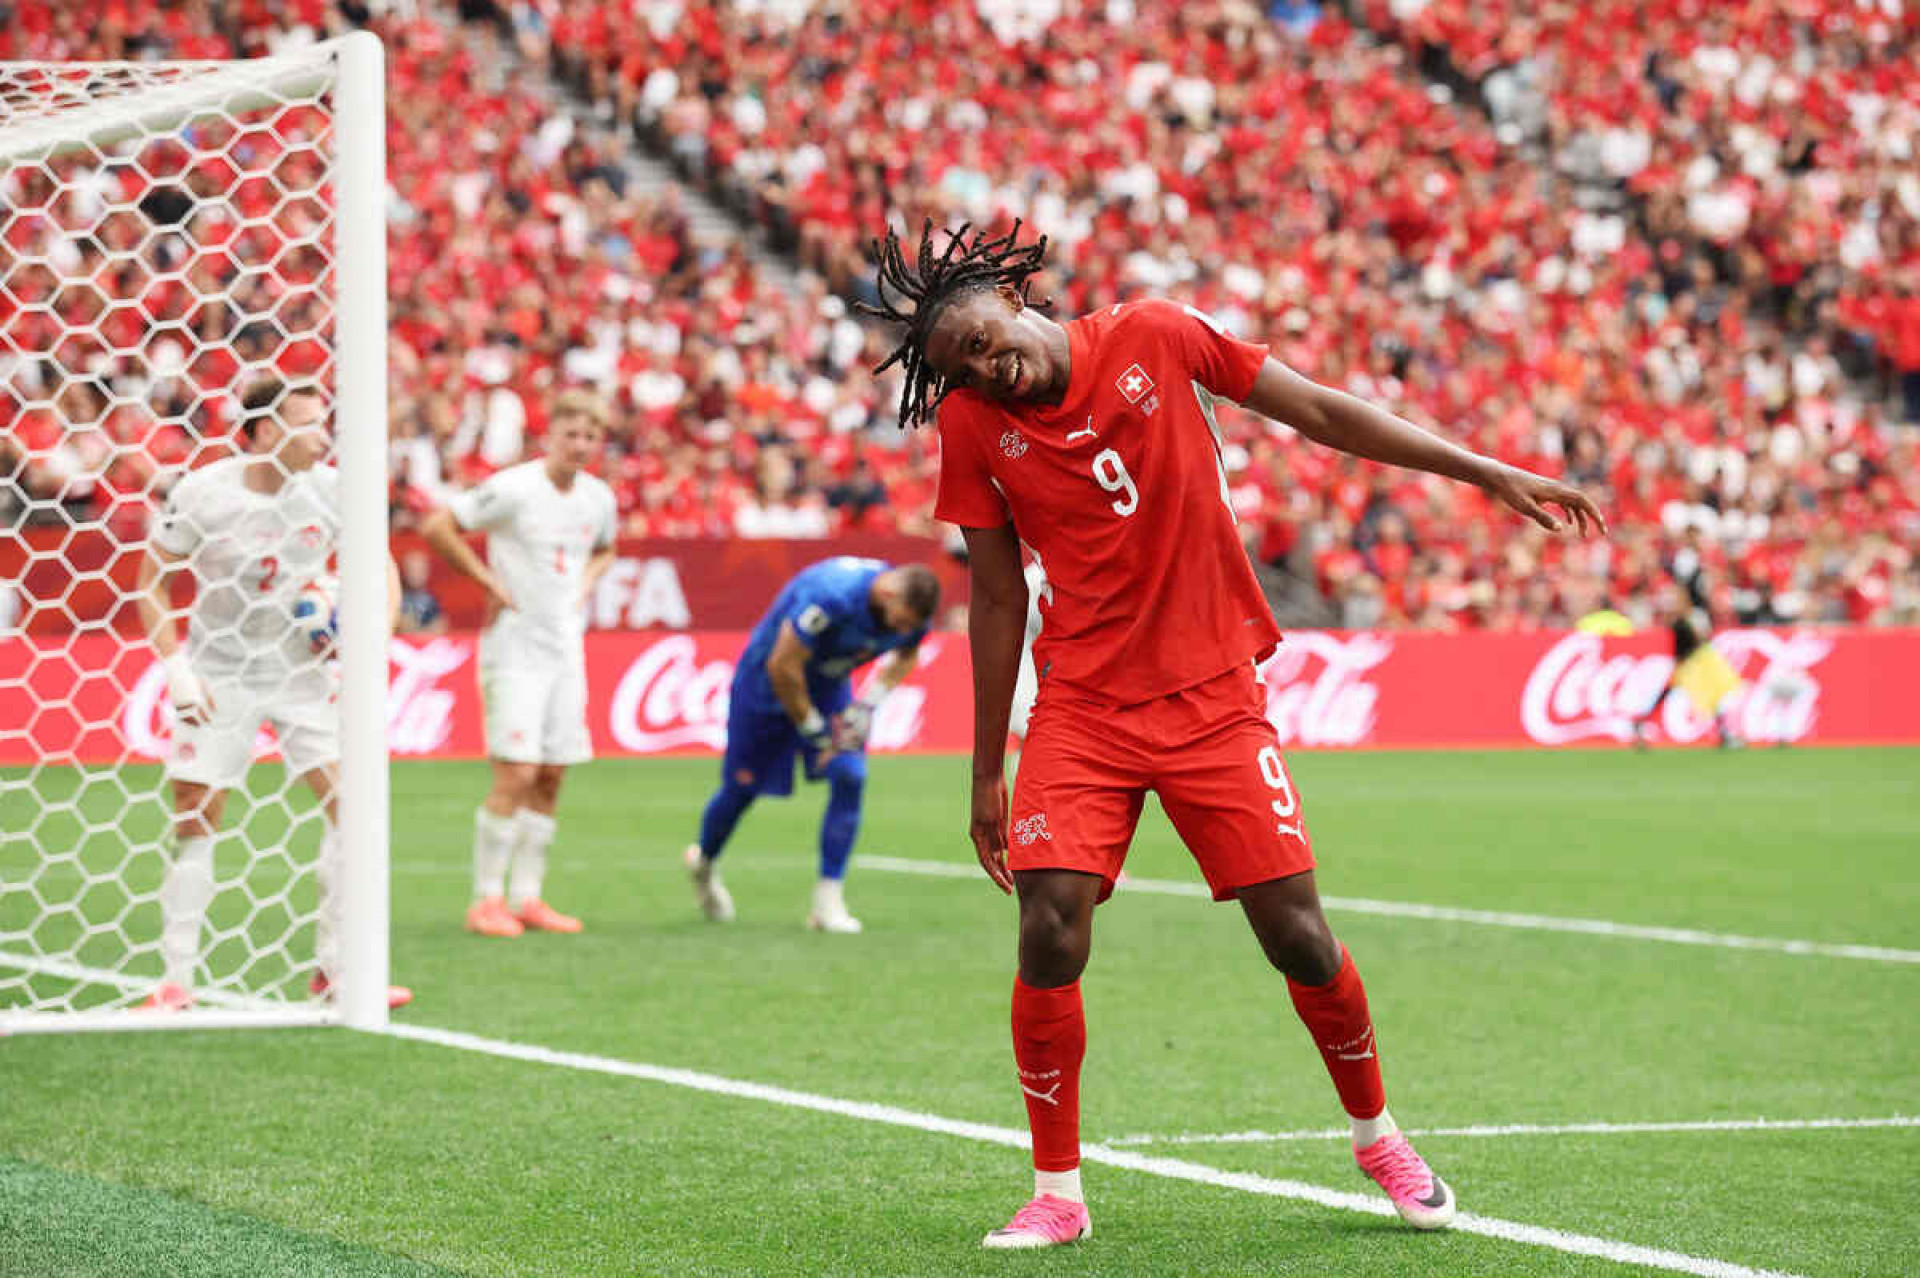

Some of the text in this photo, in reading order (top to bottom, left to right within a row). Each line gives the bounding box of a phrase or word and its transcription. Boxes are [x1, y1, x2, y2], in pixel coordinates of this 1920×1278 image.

[1092, 448, 1139, 517] 9
[259, 556, 278, 593] 2
[590, 558, 691, 630] FA
[1520, 629, 1836, 744] CocaCola
[1257, 746, 1295, 817] 9
